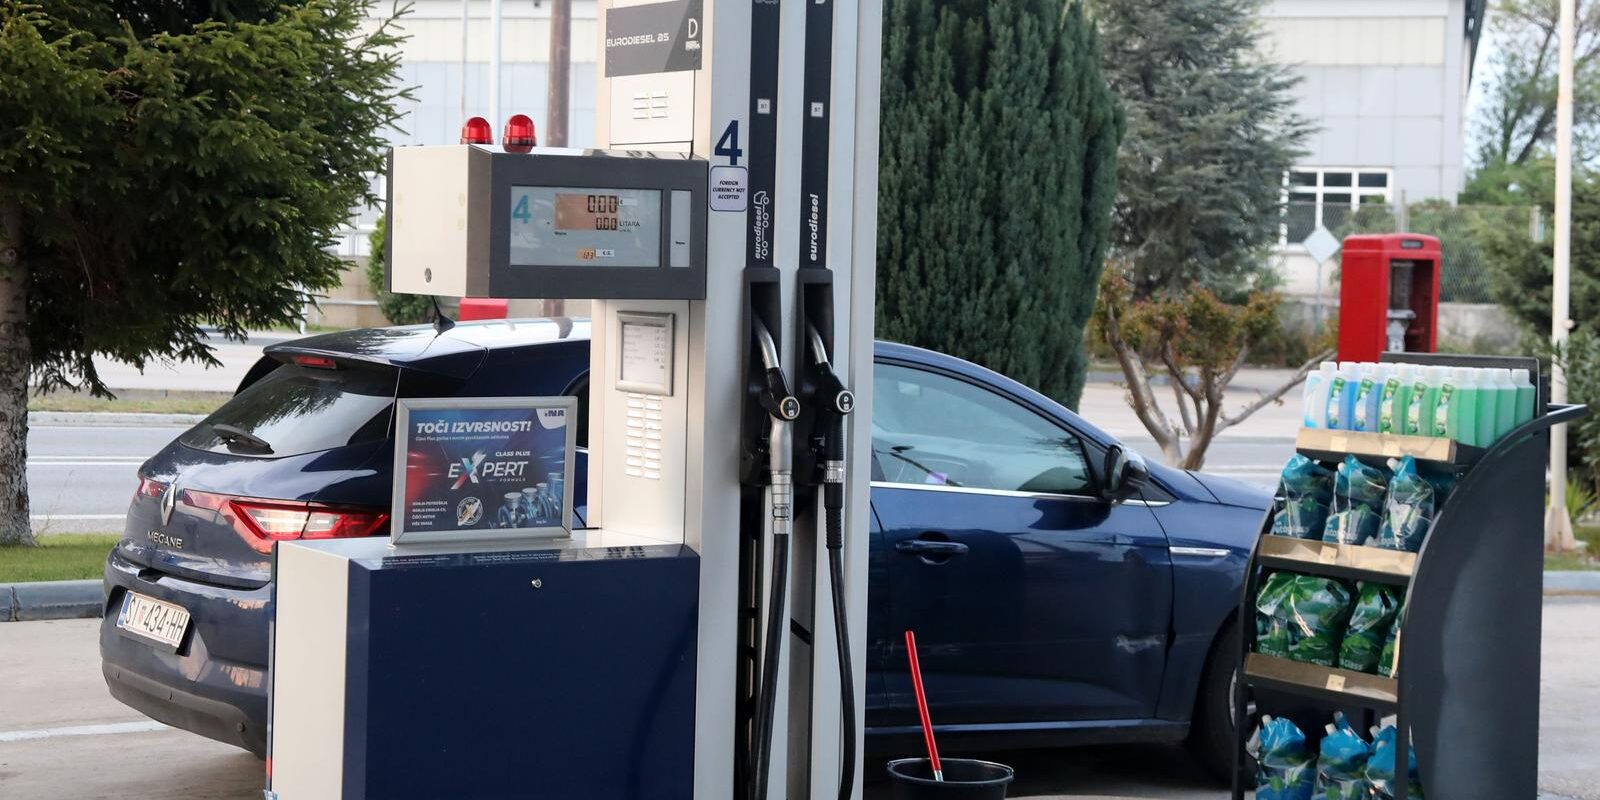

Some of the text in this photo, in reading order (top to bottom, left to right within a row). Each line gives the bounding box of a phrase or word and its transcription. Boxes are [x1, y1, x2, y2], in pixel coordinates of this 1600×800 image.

[606, 34, 656, 47] EURODIESEL
[688, 18, 699, 39] D
[714, 119, 743, 166] 4
[511, 194, 532, 225] 4
[753, 205, 762, 260] eurodiesel
[808, 193, 819, 261] eurodiesel
[416, 419, 532, 434] TOČI IZVRSNOST!
[447, 449, 529, 490] EXPERT
[147, 530, 183, 549] MEGANE
